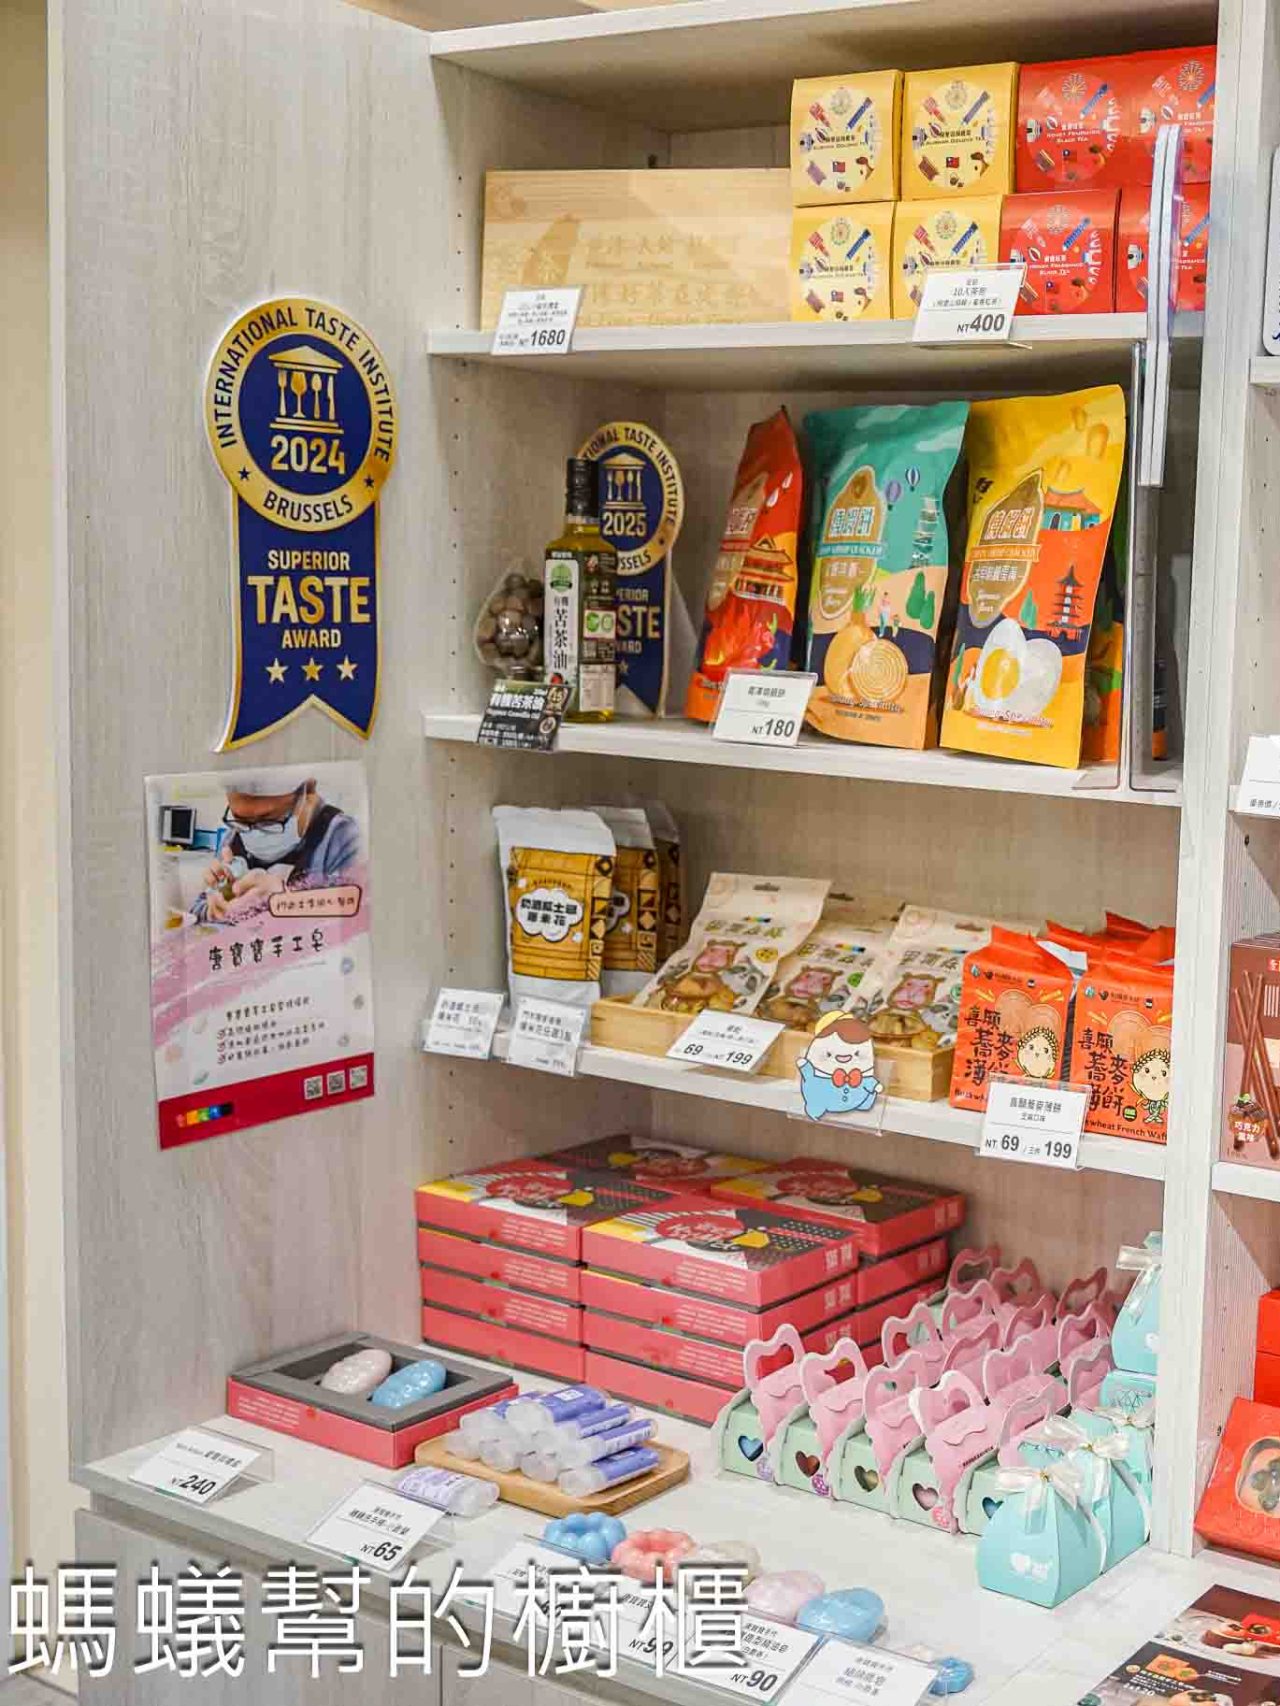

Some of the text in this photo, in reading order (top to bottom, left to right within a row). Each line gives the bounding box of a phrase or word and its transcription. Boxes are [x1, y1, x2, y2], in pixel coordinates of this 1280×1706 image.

[956, 313, 1005, 333] NT 400
[530, 329, 566, 347] 1680
[213, 305, 396, 462] INTERNATIONAL TASTE INSTITUTE
[270, 435, 346, 474] 2024
[624, 427, 678, 525] TASTE INSTITUTE
[262, 489, 354, 524] BRUSSELS
[602, 511, 647, 537] 2025
[267, 549, 351, 571] SUPERIOR
[247, 575, 371, 625] TASTE
[281, 628, 342, 650] AWARD
[553, 608, 569, 670] 苦茶油
[751, 718, 795, 738] NT 180
[965, 1005, 1001, 1030] 喜願
[1078, 1027, 1114, 1054] 喜願
[683, 1043, 753, 1065] 69 199
[1117, 1123, 1146, 1137] French
[985, 1134, 1072, 1159] NT 69 199
[179, 1474, 217, 1495] 240
[360, 1541, 402, 1562] NT 65
[628, 1638, 646, 1650] NT
[730, 1669, 778, 1692] NT 90
